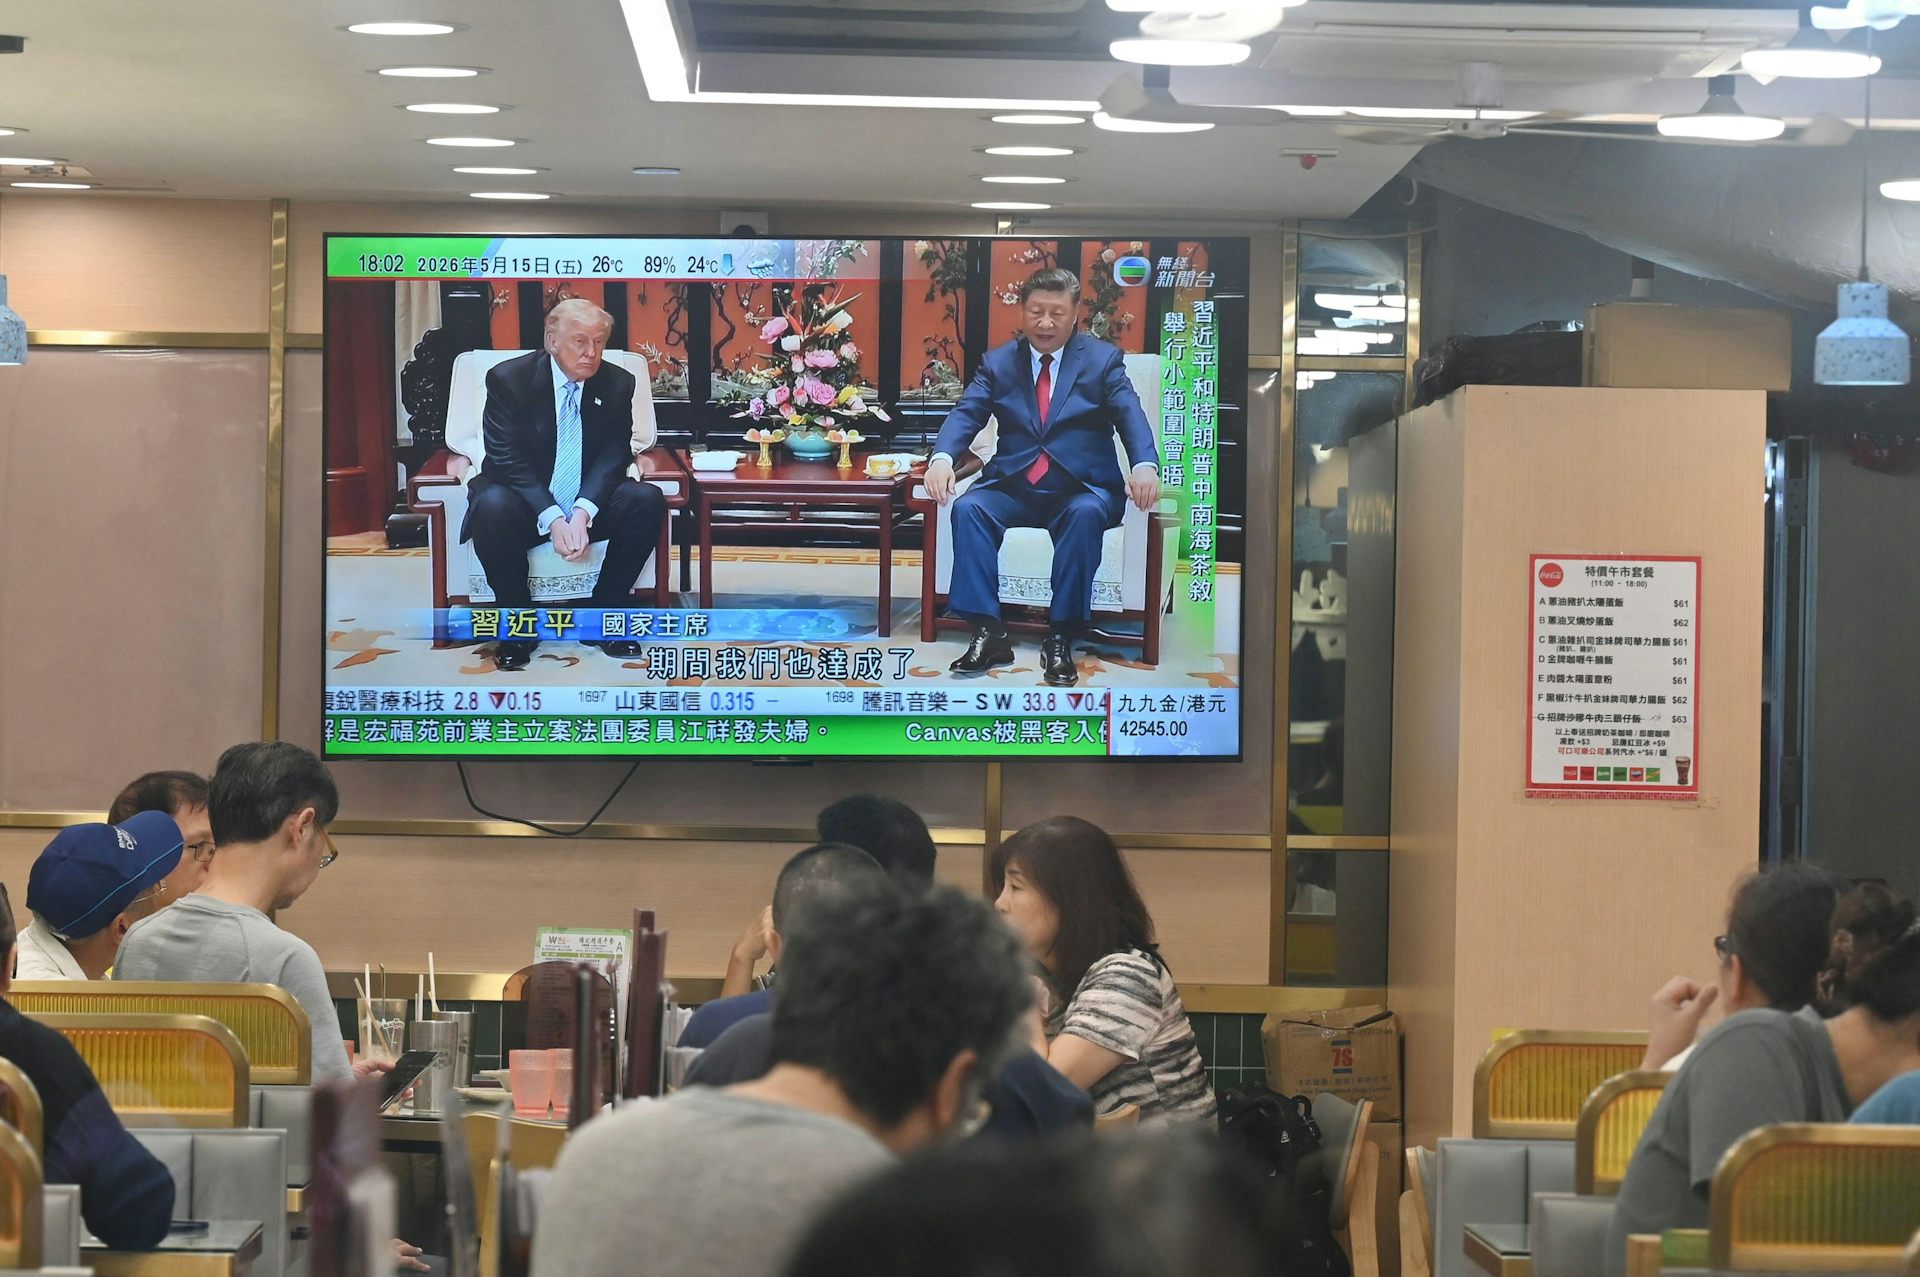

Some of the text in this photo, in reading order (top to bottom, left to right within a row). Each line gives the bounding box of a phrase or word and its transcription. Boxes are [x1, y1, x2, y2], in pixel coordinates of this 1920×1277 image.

[359, 254, 404, 273] 18:02
[418, 256, 582, 275] 2026年5月15日(五)
[644, 255, 676, 273] 89%
[1154, 270, 1216, 288] 新聞台
[1162, 311, 1186, 486] 舉行小範圍會晤
[1585, 565, 1655, 578] 特價午市套餐
[1591, 579, 1614, 587] (11:00
[1625, 580, 1648, 589] 18:00)
[1539, 598, 1546, 606] A
[1673, 600, 1689, 608] $61
[471, 609, 708, 638] 習近平 國家主席
[1539, 617, 1545, 625] B
[1673, 619, 1689, 627] $62
[1538, 636, 1545, 644] C
[1672, 638, 1688, 646] $61
[647, 647, 915, 680] 期間我們也達成了
[1538, 655, 1545, 663] D
[1672, 657, 1688, 666] $61
[1538, 674, 1544, 682] E
[1672, 677, 1688, 685] $61
[453, 691, 479, 711] 2.8
[507, 691, 542, 711] 0.15
[578, 690, 607, 703] 1697
[615, 690, 701, 712] 山東國信
[710, 691, 754, 711] 0.315
[825, 691, 854, 703] 1698
[1022, 692, 1056, 711] 33.8
[1117, 693, 1227, 713] 九九金/港元
[1672, 696, 1688, 704] $62
[1537, 713, 1544, 721] G
[1671, 715, 1687, 724] $63
[1119, 720, 1188, 737] 42545.00
[1576, 738, 1590, 746] +$3
[1652, 739, 1666, 747] +$9
[616, 942, 623, 952] A
[1331, 1048, 1353, 1067] 7S
